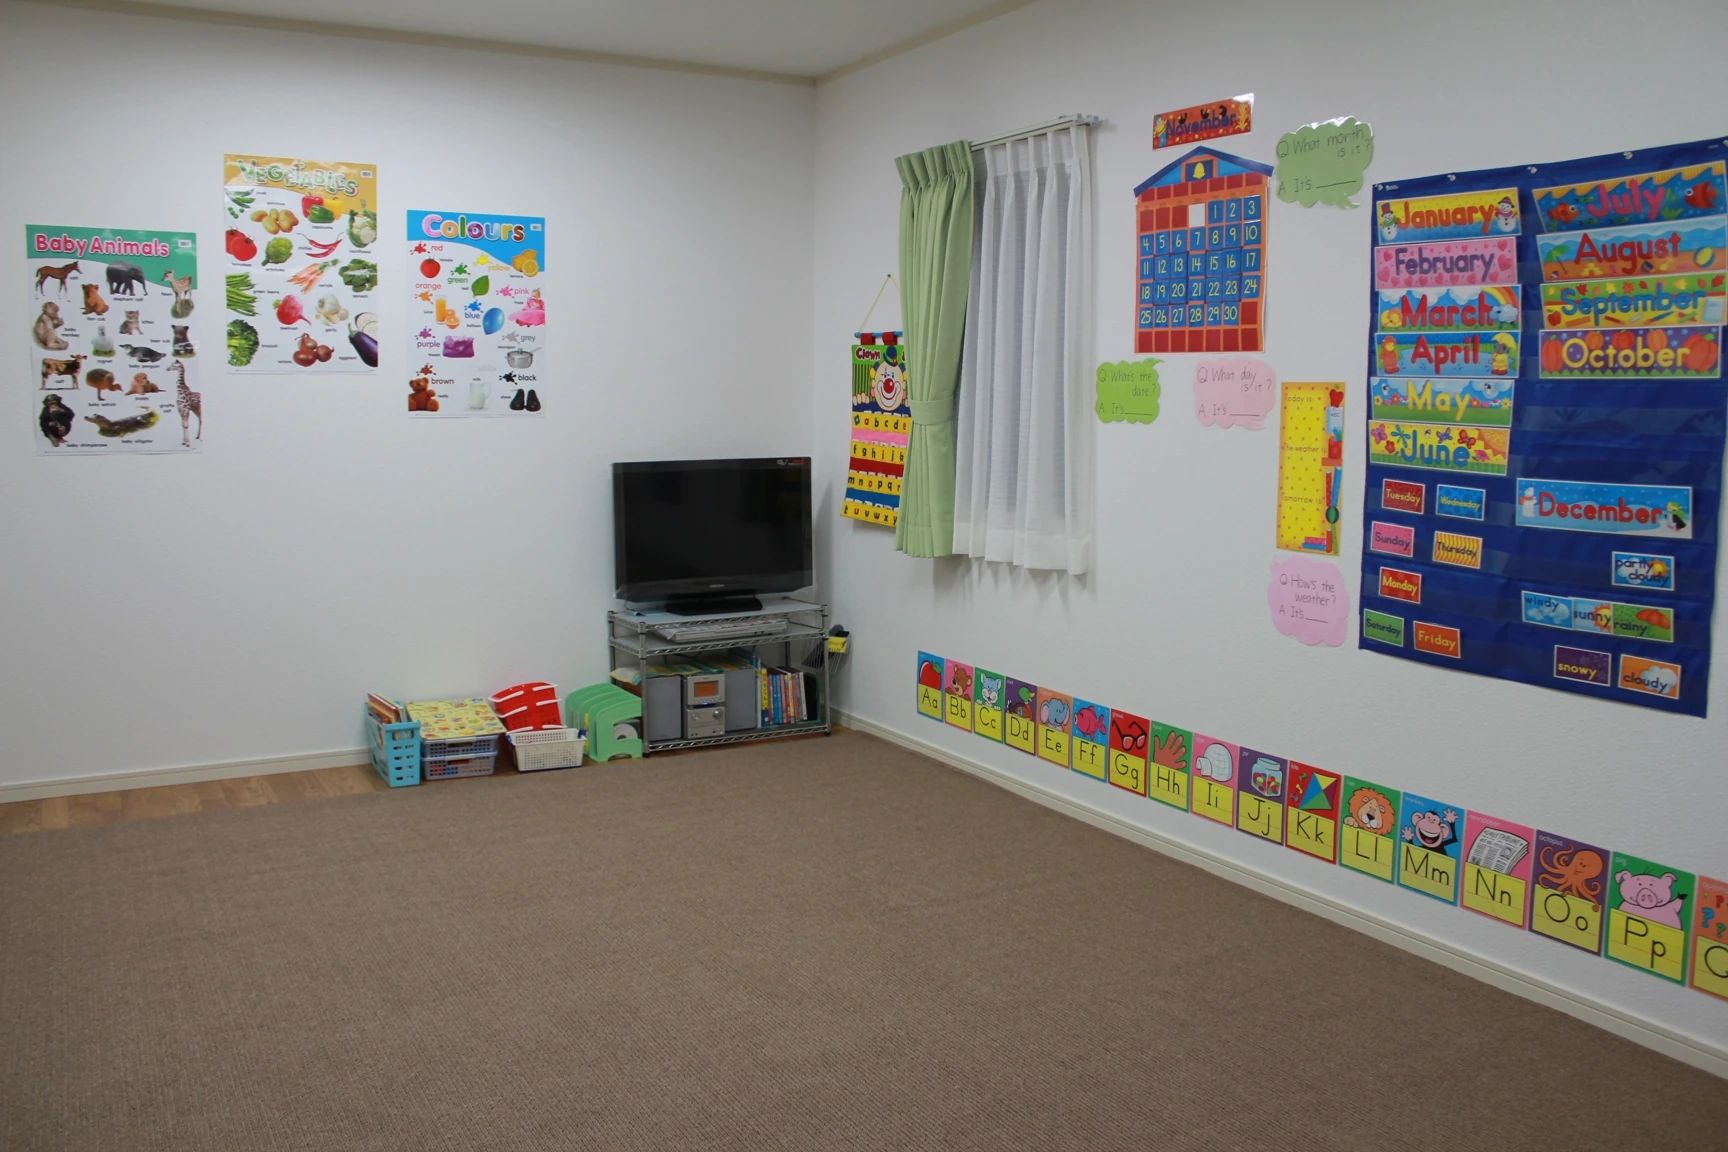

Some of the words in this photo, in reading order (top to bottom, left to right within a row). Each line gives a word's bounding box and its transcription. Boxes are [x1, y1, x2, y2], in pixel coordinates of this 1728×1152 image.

[1276, 140, 1289, 158] Q
[1293, 138, 1320, 154] What
[1213, 204, 1217, 218] 1
[1229, 202, 1236, 216] 2
[1248, 200, 1256, 214] 3
[1587, 179, 1666, 221] July
[1395, 200, 1496, 234] January
[422, 213, 526, 243] Colours
[35, 233, 87, 256] Baby
[90, 235, 170, 257] Animals
[1142, 237, 1150, 250] 4
[1158, 234, 1164, 248] 5
[1176, 233, 1182, 248] 6
[1194, 232, 1200, 245] 7
[1212, 230, 1218, 244] 8
[1229, 228, 1236, 242] 9
[1246, 225, 1258, 240] 10
[430, 244, 443, 252] red
[1574, 232, 1682, 275] August
[1142, 262, 1149, 272] 11
[1158, 258, 1167, 272] 12
[1174, 256, 1183, 270] 13
[1191, 256, 1201, 268] 14
[1209, 254, 1218, 268] 15
[1226, 252, 1236, 266] 16
[1246, 250, 1256, 265] 17
[1394, 247, 1495, 282] February
[415, 283, 442, 292] orange
[447, 277, 469, 286] green
[1142, 286, 1150, 298] 18
[1157, 284, 1166, 298] 19
[1172, 283, 1184, 297] 20
[1192, 282, 1201, 296] 21
[1208, 282, 1220, 296] 22
[1225, 280, 1238, 295] 23
[1244, 279, 1257, 294] 24
[514, 287, 530, 296] pink
[1400, 292, 1495, 327] March
[1560, 282, 1707, 326] September
[464, 312, 481, 320] blue
[1140, 309, 1151, 324] 25
[1156, 309, 1167, 324] 26
[1172, 308, 1183, 323] 27
[1190, 308, 1202, 323] 28
[1208, 306, 1220, 321] 29
[1223, 306, 1237, 320] 30
[416, 341, 441, 350] purple
[520, 335, 536, 344] grey
[855, 347, 881, 361] Clown
[1410, 335, 1480, 375] April
[1561, 336, 1691, 368] October
[431, 377, 455, 385] brown
[518, 374, 537, 382] black
[1097, 368, 1107, 383] Q
[1139, 370, 1153, 381] the
[1197, 366, 1208, 384] Q
[1211, 367, 1235, 382] What
[1240, 366, 1256, 387] day
[1240, 383, 1249, 393] is
[1198, 403, 1206, 416] A
[1406, 380, 1471, 422] May
[1400, 430, 1471, 467] June
[1385, 489, 1421, 505] Tuesday
[1440, 496, 1481, 512] Wednesday
[1538, 491, 1665, 524] December
[1375, 532, 1410, 551] Sunday
[1436, 541, 1477, 559] Thursday
[1615, 558, 1655, 575] partly
[1280, 573, 1288, 585] Q
[1321, 579, 1336, 593] the
[1382, 575, 1418, 597] Monday
[1628, 570, 1670, 585] cloudy
[1295, 592, 1337, 607] weather?
[1524, 595, 1559, 613] windy
[1279, 604, 1286, 615] A
[1366, 618, 1401, 637] Saturday
[1574, 610, 1612, 628] sunny
[1613, 619, 1649, 636] rainy
[1418, 630, 1456, 650] Friday
[1557, 663, 1598, 681] snowy
[1622, 673, 1668, 693] cloudy
